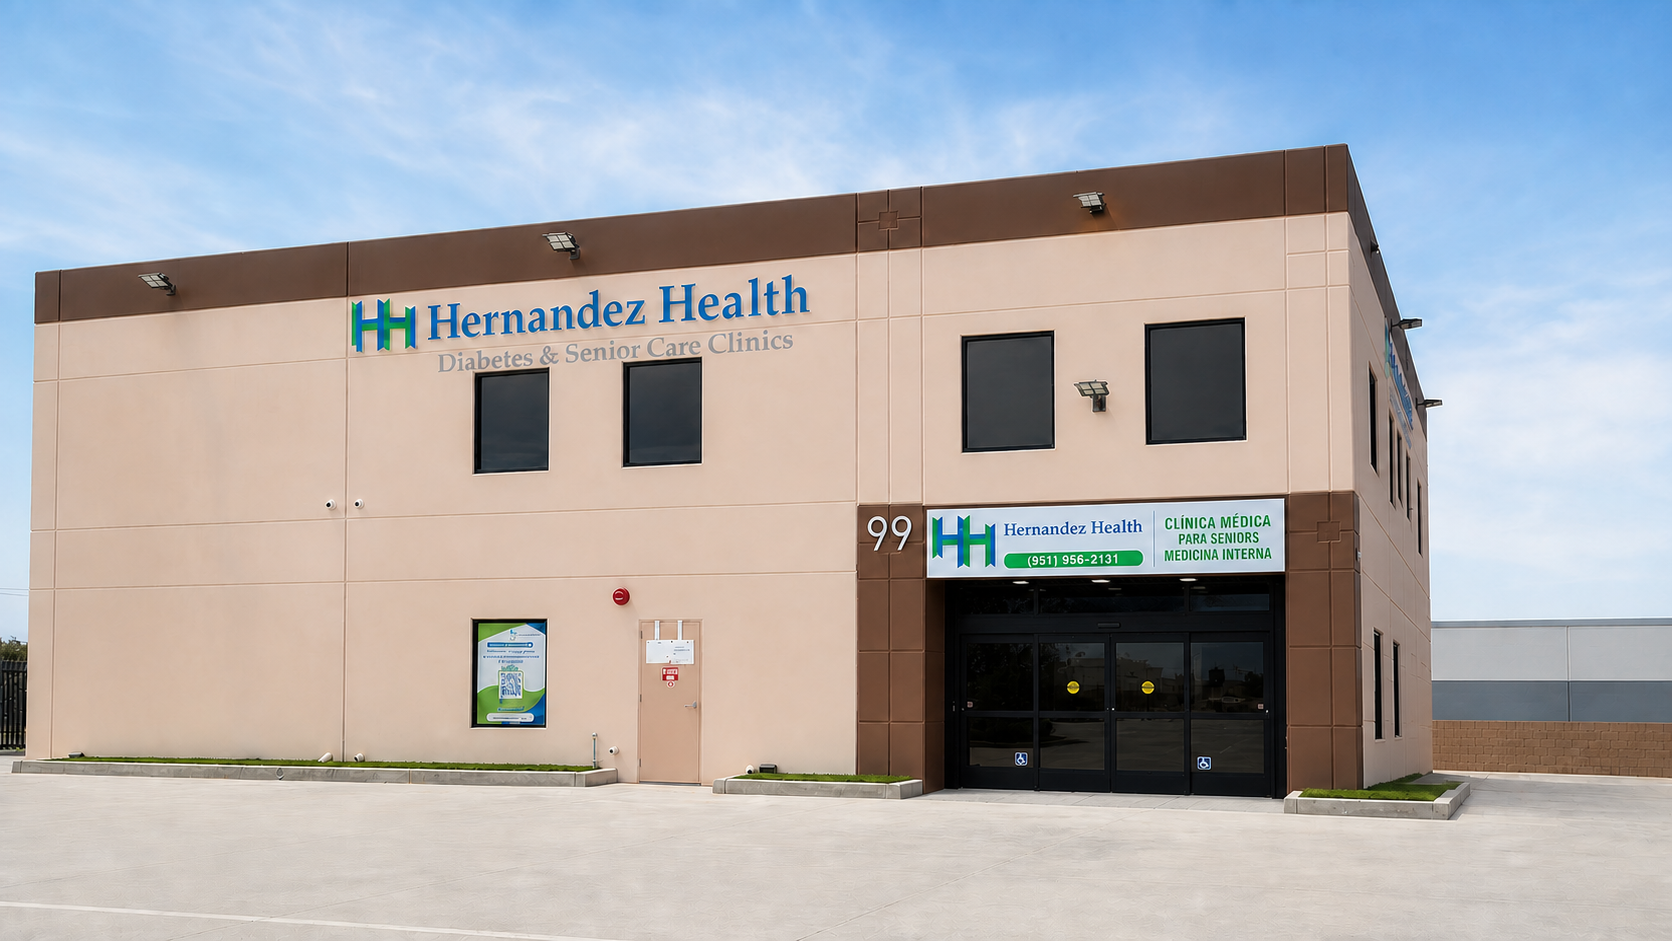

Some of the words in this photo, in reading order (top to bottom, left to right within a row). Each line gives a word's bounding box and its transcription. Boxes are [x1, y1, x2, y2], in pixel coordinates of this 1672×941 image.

[427, 290, 646, 341] Hernandez
[658, 274, 810, 323] Health
[437, 352, 535, 373] Diabetes
[539, 346, 560, 366] &
[565, 340, 641, 364] Senior
[646, 336, 702, 359] Care
[708, 330, 795, 354] Clinics
[1004, 520, 1086, 537] Hernandez
[1091, 518, 1143, 535] Health
[1164, 514, 1216, 530] CLÍNICA
[1220, 513, 1271, 529] MÉDICA
[867, 515, 913, 552] 99
[1178, 532, 1207, 545] PARA
[1210, 531, 1260, 544] SENIORS
[1027, 555, 1058, 568] (951)
[1062, 553, 1118, 565] 956-2131
[1164, 547, 1219, 562] MEDICINA
[1222, 546, 1272, 561] INTERNA
